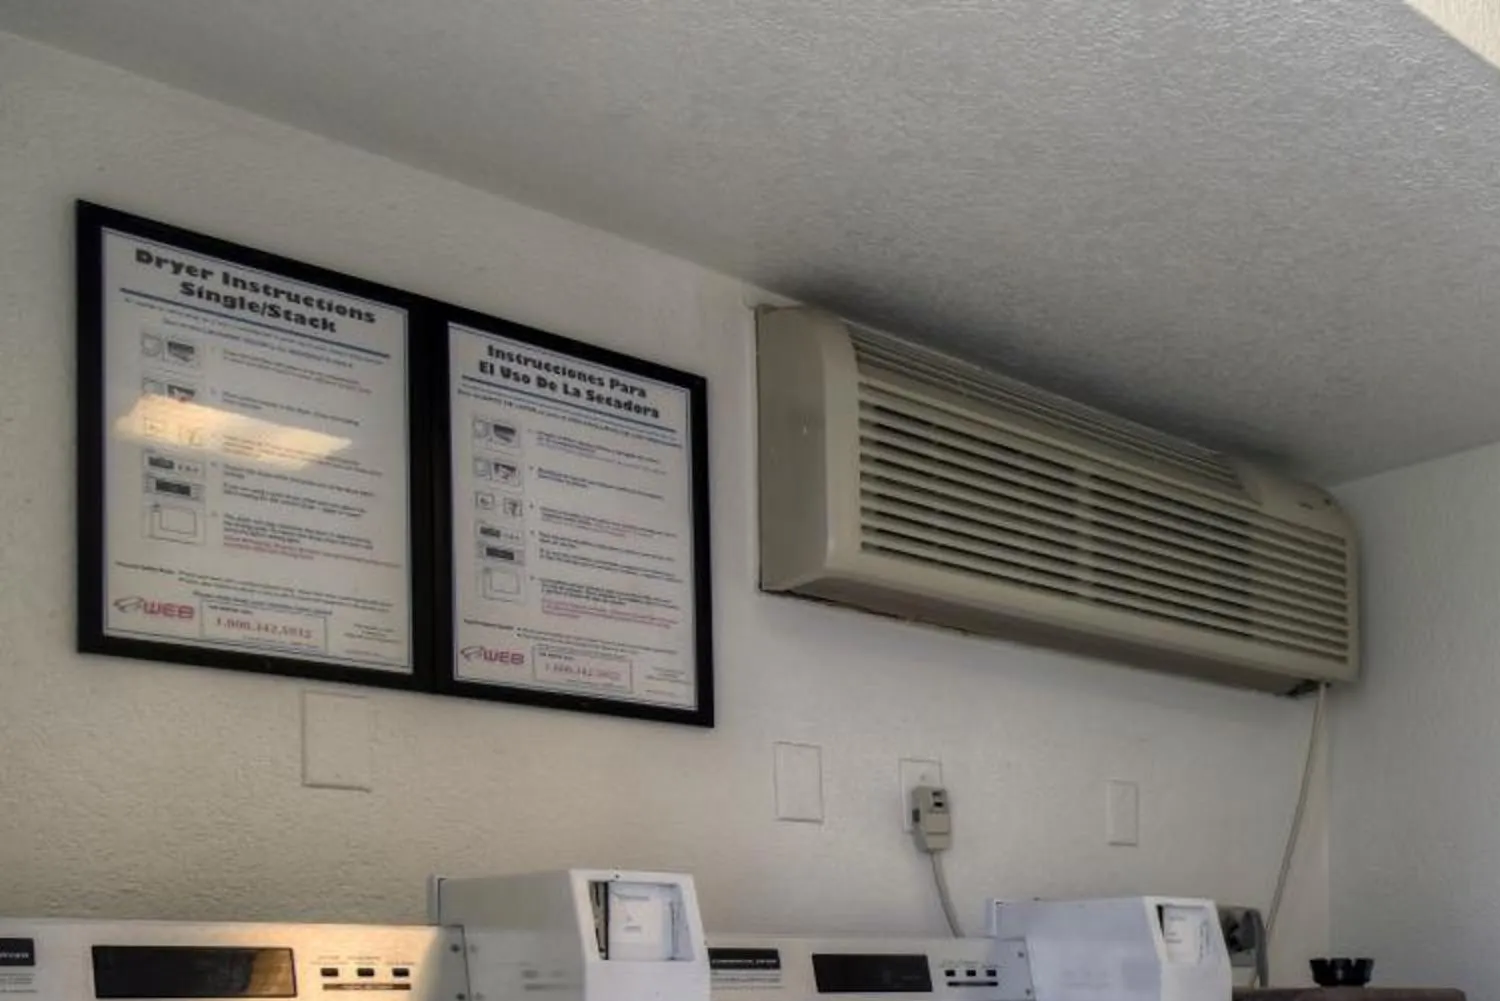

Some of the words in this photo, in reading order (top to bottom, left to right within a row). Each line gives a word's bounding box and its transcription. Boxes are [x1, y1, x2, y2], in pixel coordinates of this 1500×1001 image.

[134, 248, 214, 281] Dryer
[221, 270, 377, 325] Instructions
[179, 282, 338, 334] Single/Stack
[478, 360, 495, 377] El
[500, 365, 530, 385] Uso
[535, 376, 558, 394] De
[562, 383, 582, 399] La
[586, 388, 661, 420] Secadora
[486, 344, 605, 389] Instrucciones
[609, 379, 647, 399] Para
